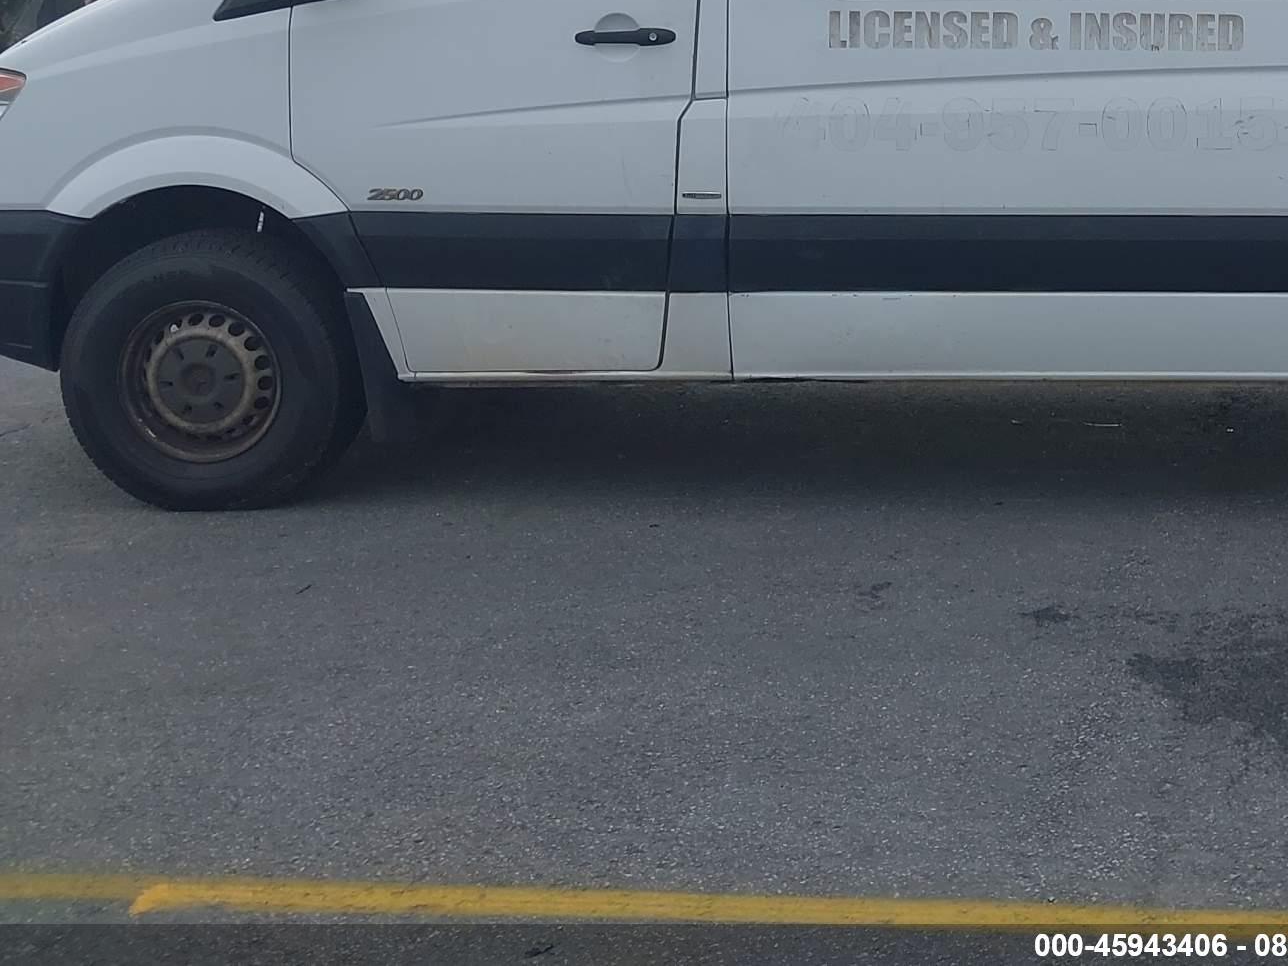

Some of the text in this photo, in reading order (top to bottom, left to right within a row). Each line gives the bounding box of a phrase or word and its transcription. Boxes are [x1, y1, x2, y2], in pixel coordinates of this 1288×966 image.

[828, 10, 1245, 52] LICENSED & INSURED
[367, 188, 424, 201] 2500
